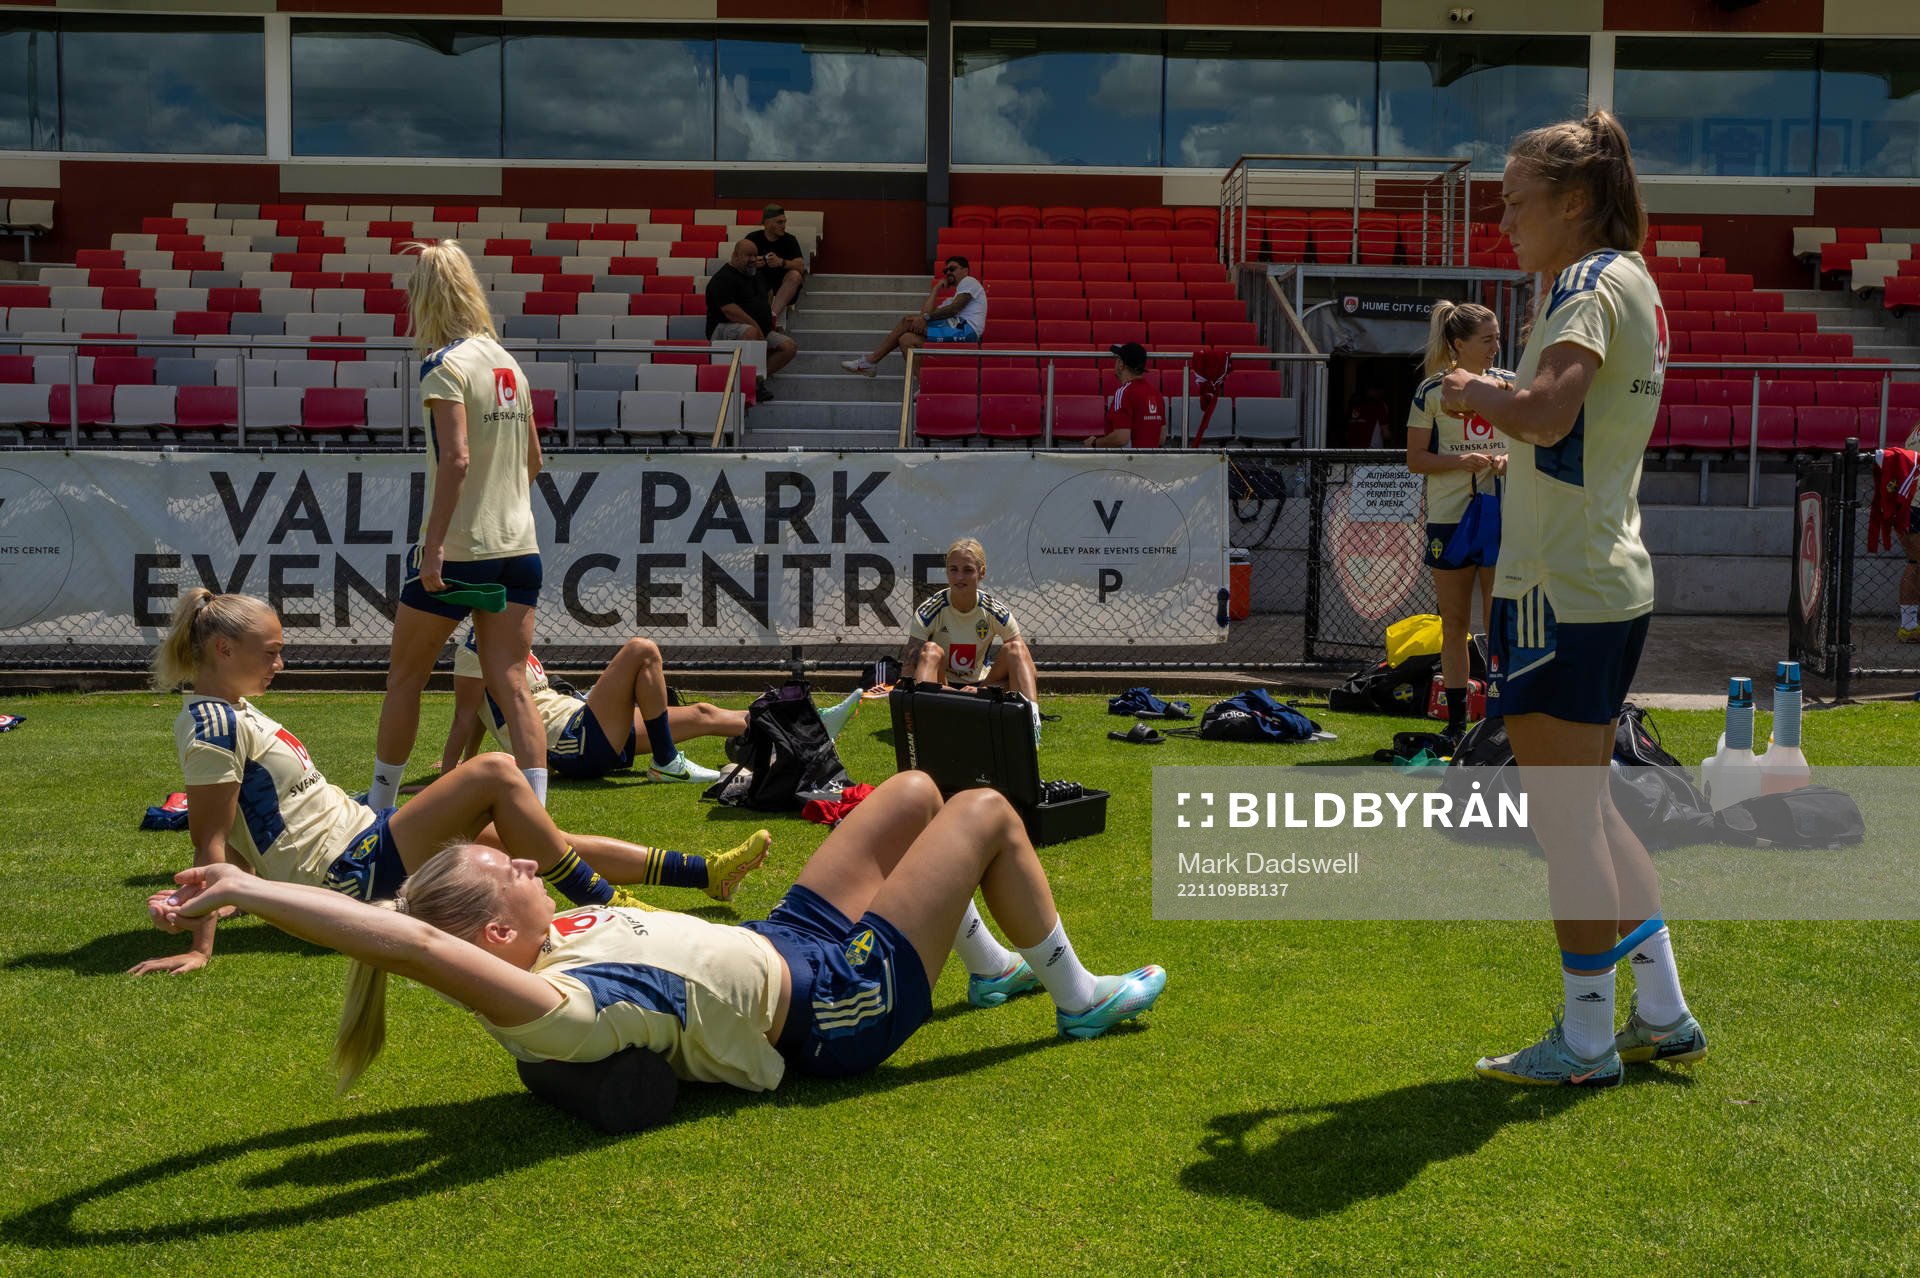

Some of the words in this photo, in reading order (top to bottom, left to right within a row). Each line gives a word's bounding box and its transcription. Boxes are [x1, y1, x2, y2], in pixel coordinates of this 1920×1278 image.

[1361, 301, 1390, 311] HUME
[1392, 303, 1415, 312] CITY
[1450, 443, 1488, 451] SVENSKA
[1489, 441, 1506, 449] SPEL
[1366, 490, 1406, 498] PERMITTED
[211, 471, 600, 545] VALLY
[640, 469, 892, 544] PARK
[1093, 500, 1123, 534] V
[22, 546, 60, 555] CENTRE
[1041, 547, 1075, 555] VALLEY
[1078, 547, 1100, 555] PARK
[1103, 547, 1139, 555] EVENTS
[1142, 547, 1177, 555] CENTRE
[1099, 568, 1123, 603] P
